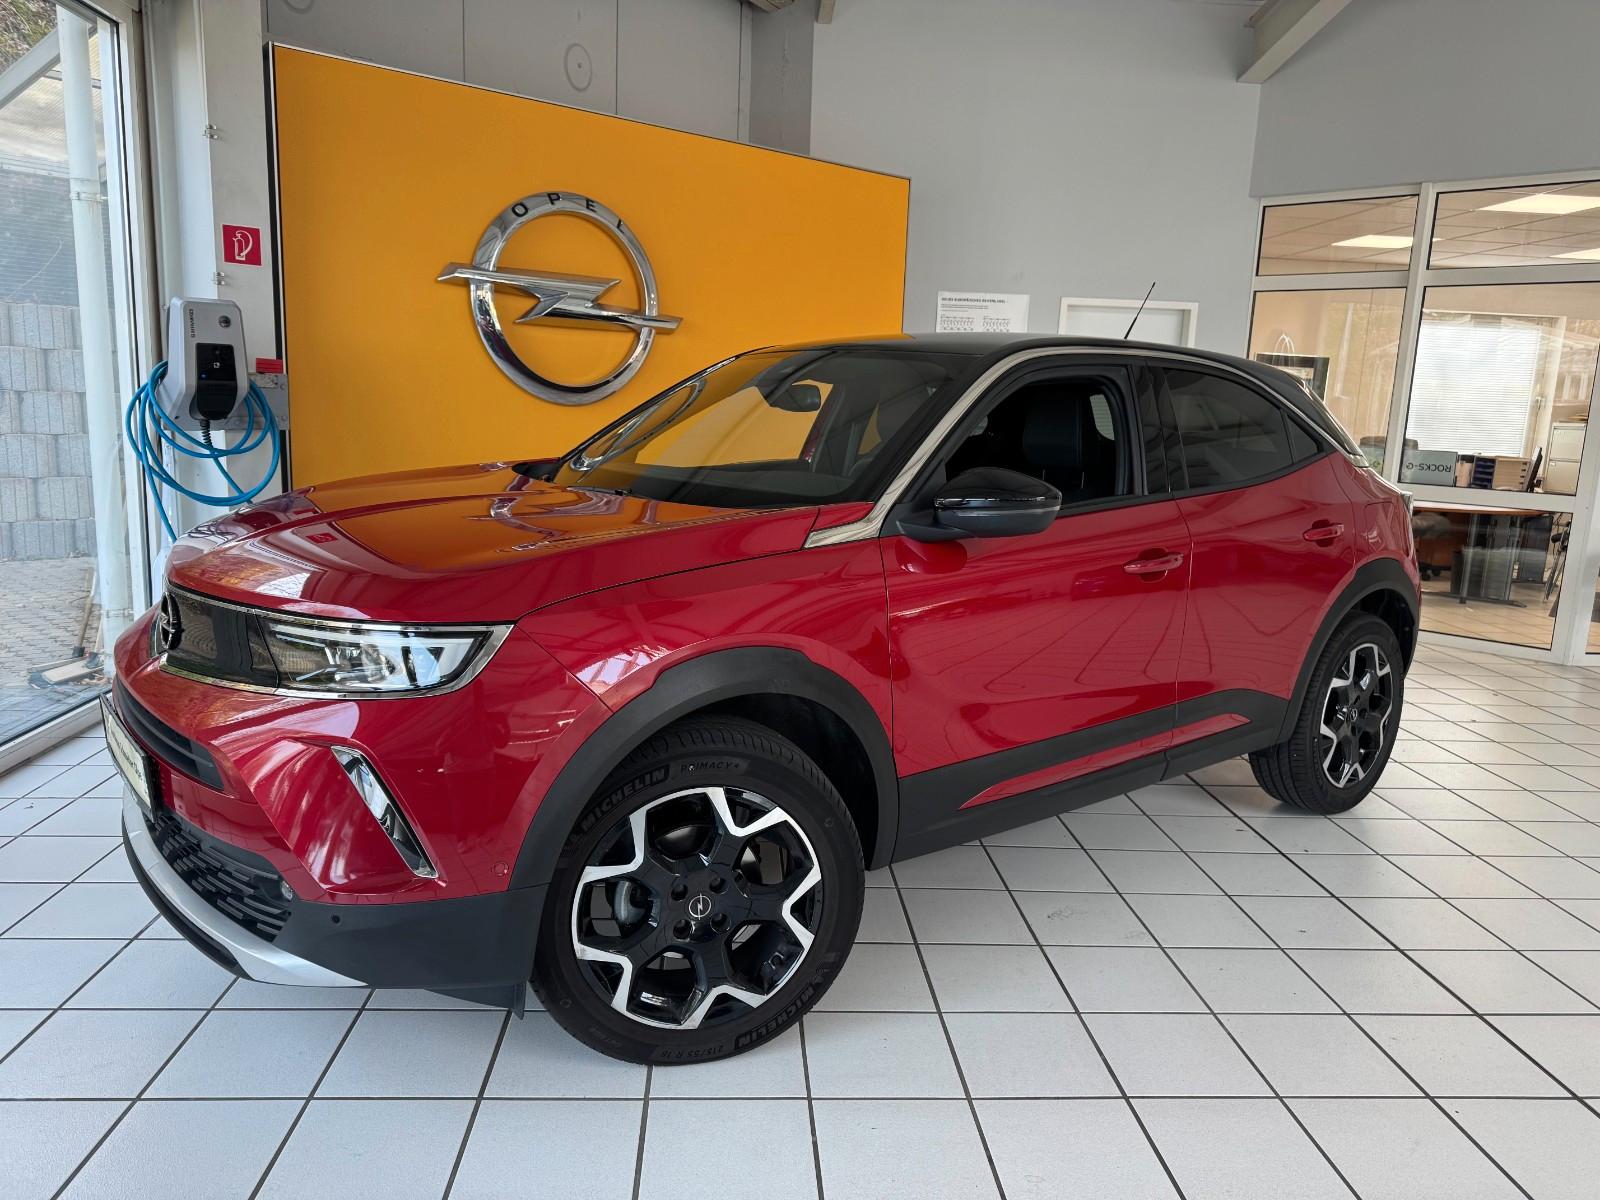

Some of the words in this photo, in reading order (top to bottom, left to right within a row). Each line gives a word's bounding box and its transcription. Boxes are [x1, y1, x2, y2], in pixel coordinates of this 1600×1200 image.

[511, 191, 625, 234] OPEL
[580, 767, 665, 832] MICHELIN
[738, 986, 814, 1047] MICHELIN
